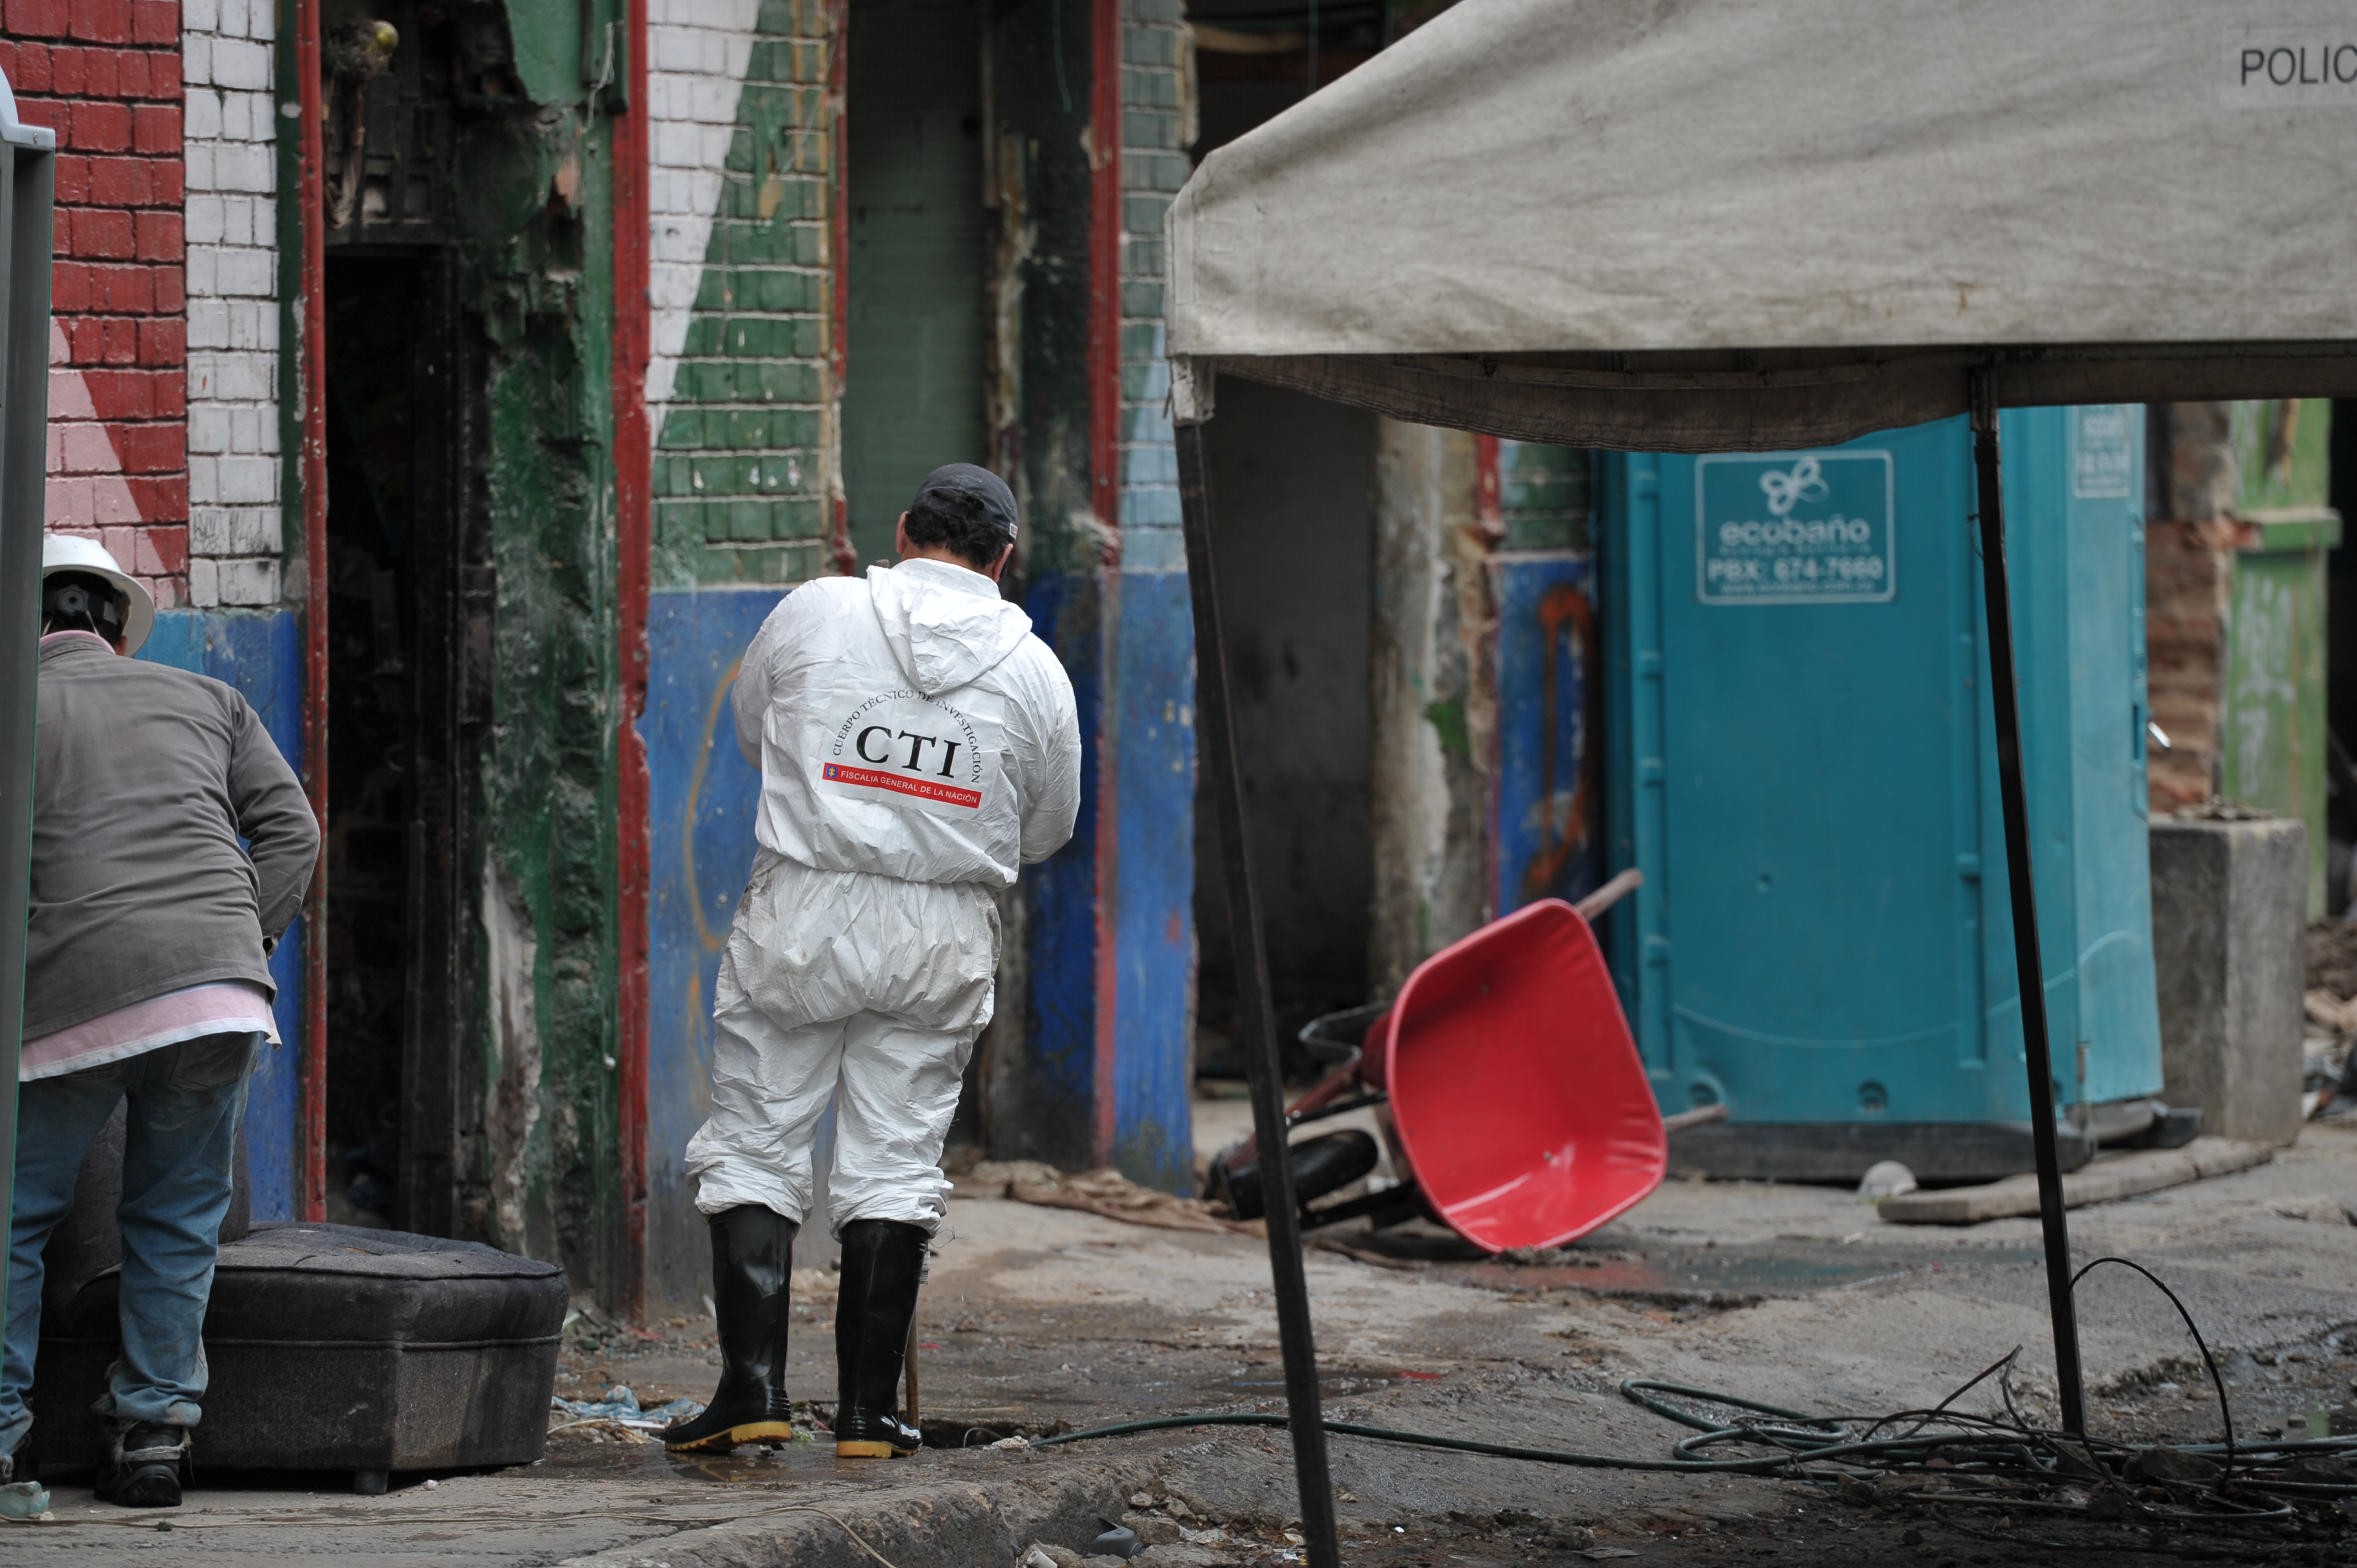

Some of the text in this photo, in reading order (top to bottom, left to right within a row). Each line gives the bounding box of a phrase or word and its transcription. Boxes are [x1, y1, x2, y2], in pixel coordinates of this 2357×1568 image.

[2241, 45, 2357, 86] POLIC
[1720, 514, 1870, 545] ecobaño
[833, 690, 983, 784] CUERPO TÉCNICO DE INVESTIGACIÓN
[856, 726, 961, 778] CTI
[880, 776, 918, 791] GENERAL
[920, 786, 932, 794] DE
[945, 791, 977, 803] NACIÓN
